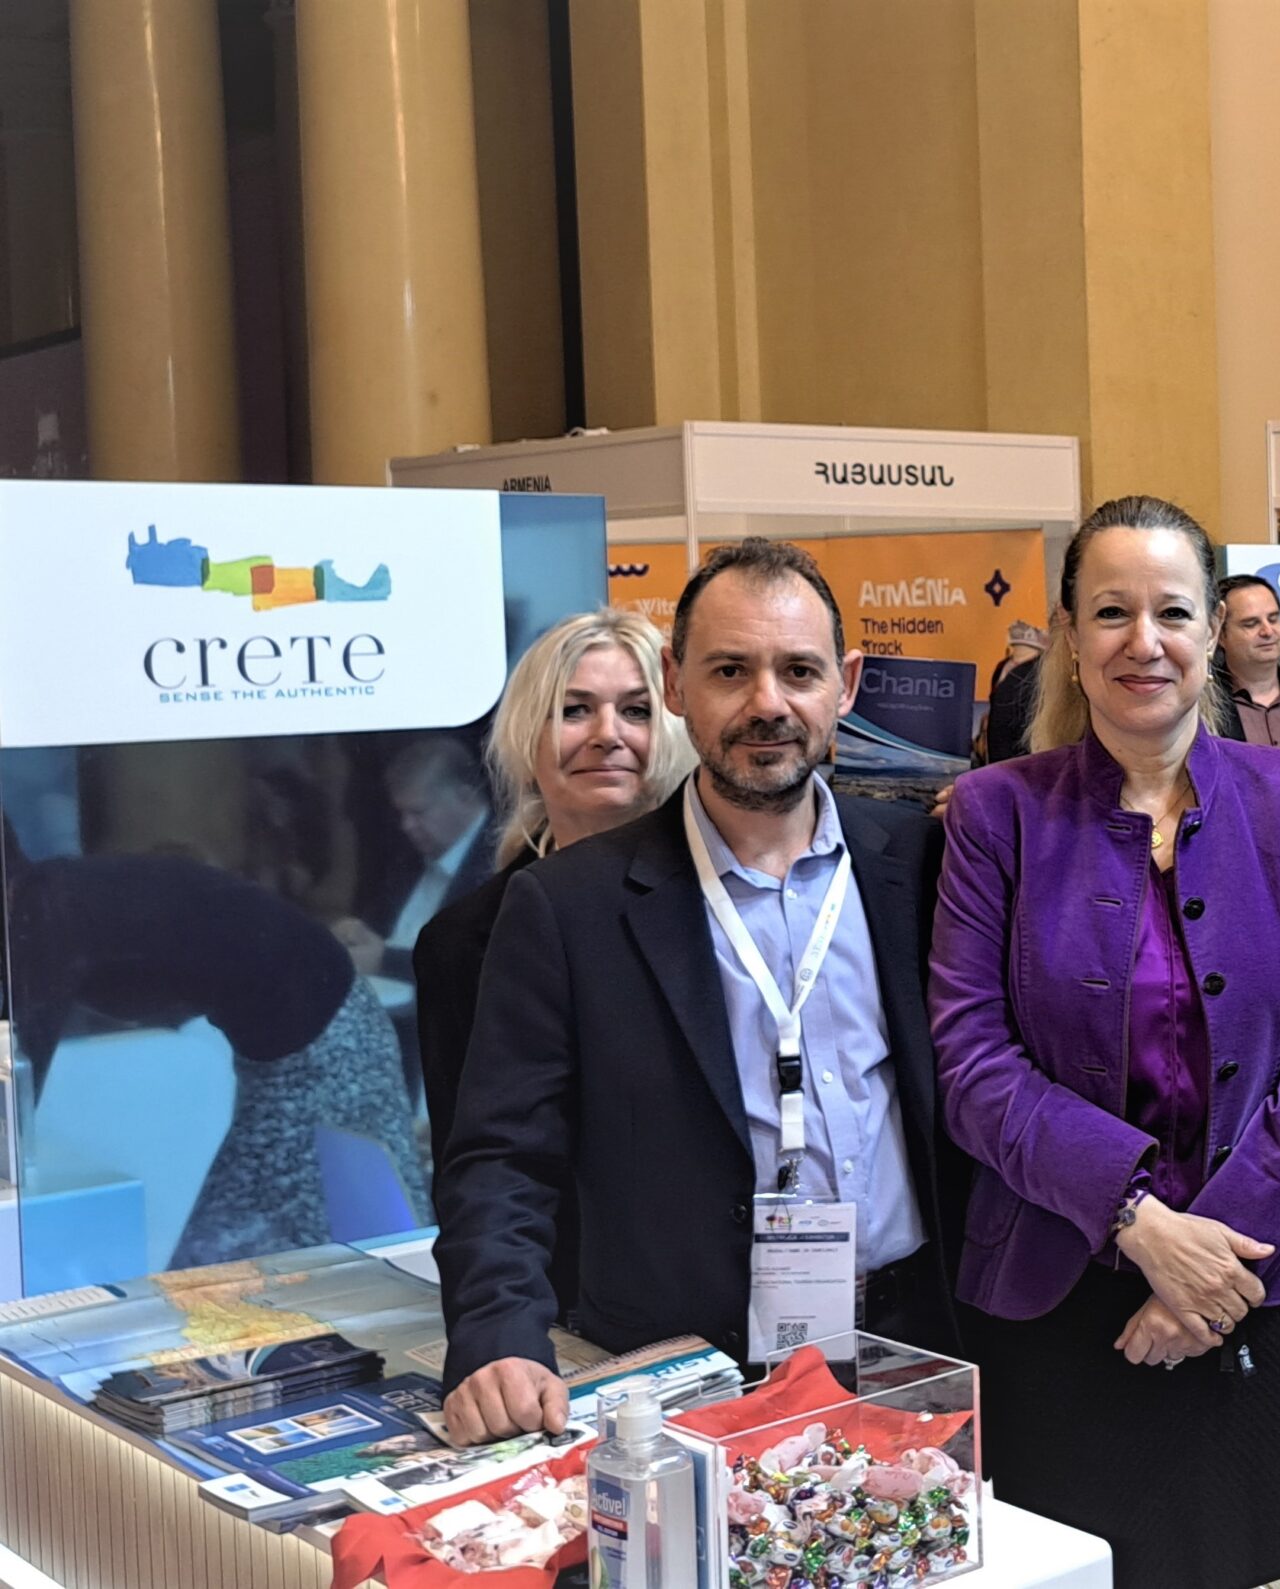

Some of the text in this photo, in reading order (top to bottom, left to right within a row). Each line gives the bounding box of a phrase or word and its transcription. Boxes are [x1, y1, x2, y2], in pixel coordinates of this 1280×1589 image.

[503, 475, 552, 493] ARMENIA
[861, 617, 945, 634] The Hidden
[862, 640, 903, 655] Track
[860, 668, 955, 698] Chania
[159, 685, 376, 704] SENSE THE AUTHENTIC
